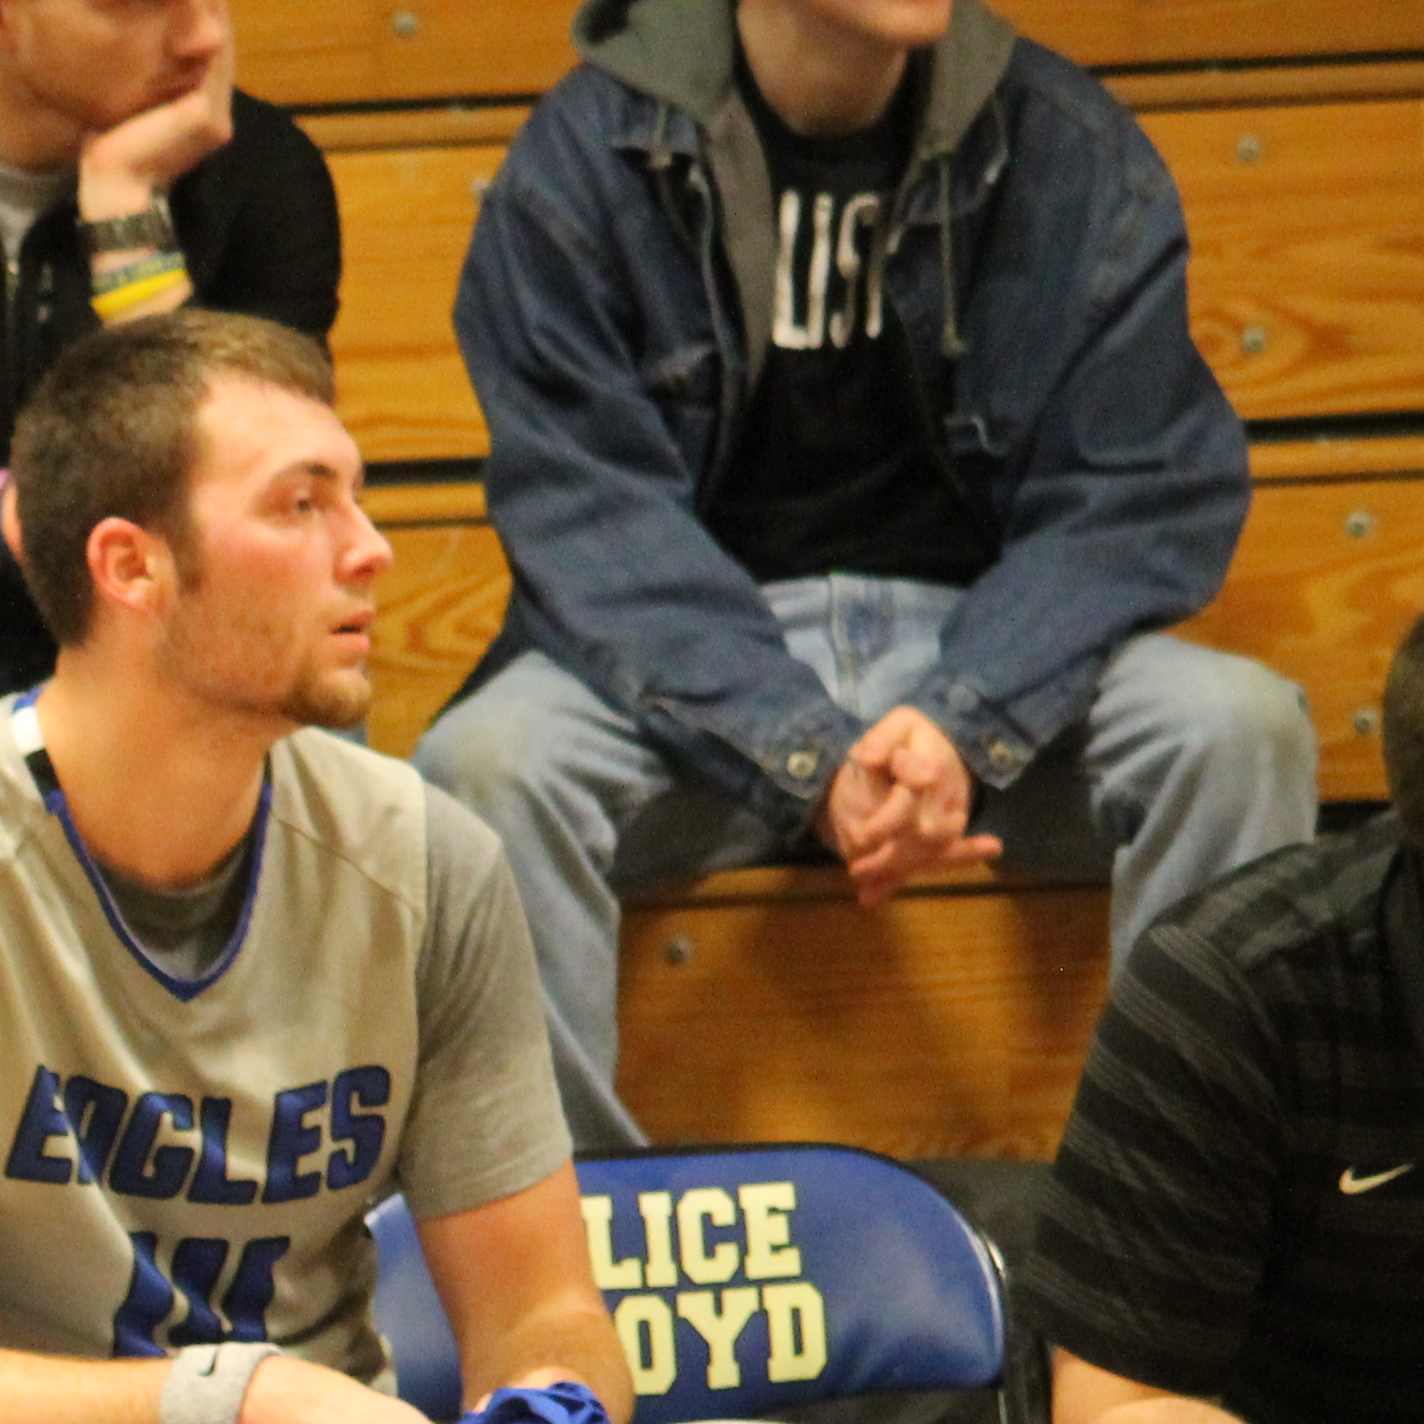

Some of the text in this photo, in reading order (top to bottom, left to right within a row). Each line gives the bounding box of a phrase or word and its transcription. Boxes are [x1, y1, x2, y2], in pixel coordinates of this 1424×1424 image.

[4, 1064, 392, 1206] EAGLES
[580, 1181, 803, 1290] LICE
[614, 1282, 828, 1396] OYD
